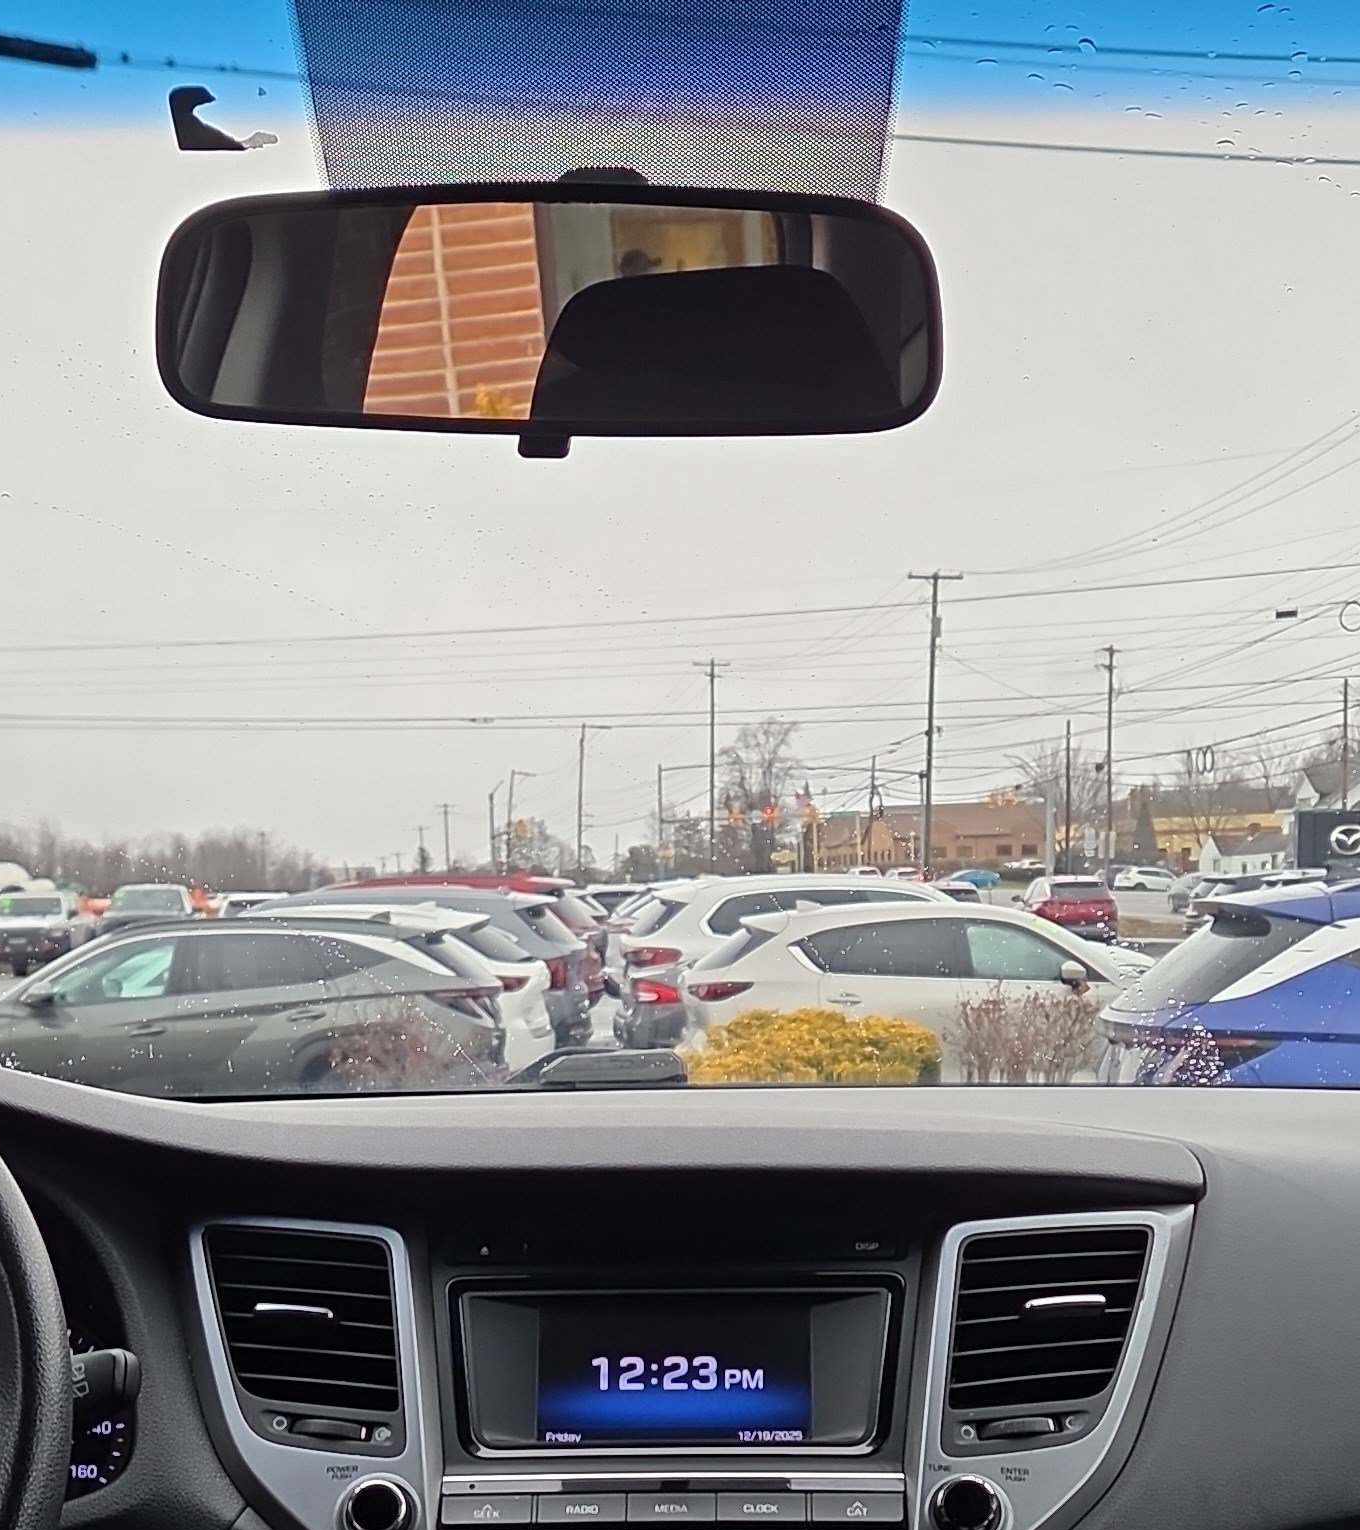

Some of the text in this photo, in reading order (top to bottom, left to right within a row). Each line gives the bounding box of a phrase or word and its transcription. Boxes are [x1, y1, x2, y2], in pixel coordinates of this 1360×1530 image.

[854, 1242, 879, 1251] DISP
[591, 1355, 764, 1391] 12:23 PM
[545, 1431, 582, 1443] Friday
[70, 1464, 98, 1479] 160
[326, 1464, 359, 1475] POWER
[1001, 1466, 1030, 1476] ENTER
[473, 1508, 501, 1520] SEEK
[565, 1503, 599, 1515] RADIO
[654, 1503, 688, 1514] MEDIA
[743, 1503, 779, 1514] CLOCK
[846, 1505, 869, 1517] CAT
